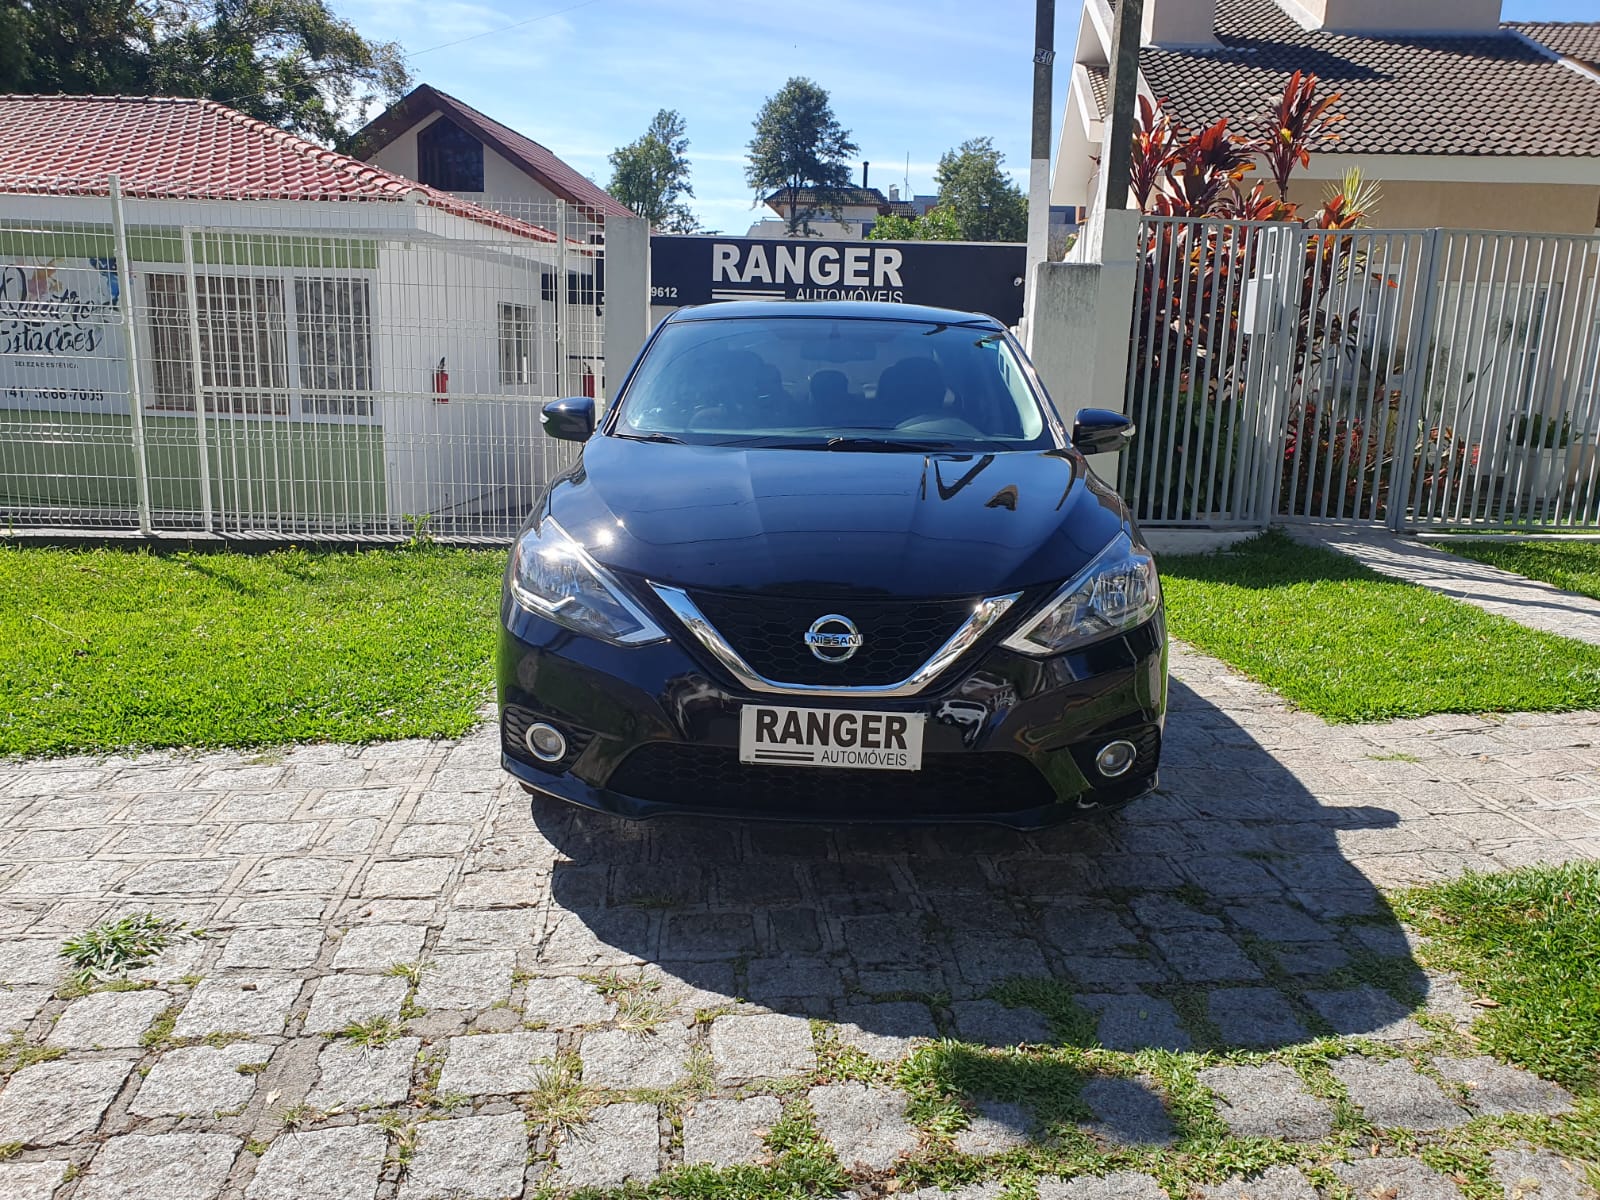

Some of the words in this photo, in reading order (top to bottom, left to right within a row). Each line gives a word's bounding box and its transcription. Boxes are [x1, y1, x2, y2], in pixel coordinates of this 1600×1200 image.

[712, 243, 904, 287] RANGER
[651, 287, 678, 298] 9612
[795, 287, 904, 303] AUTOMÓVEIS
[811, 635, 857, 645] NISSAN
[755, 709, 908, 750] RANGER
[820, 748, 908, 766] AUTOMÓVEIS
